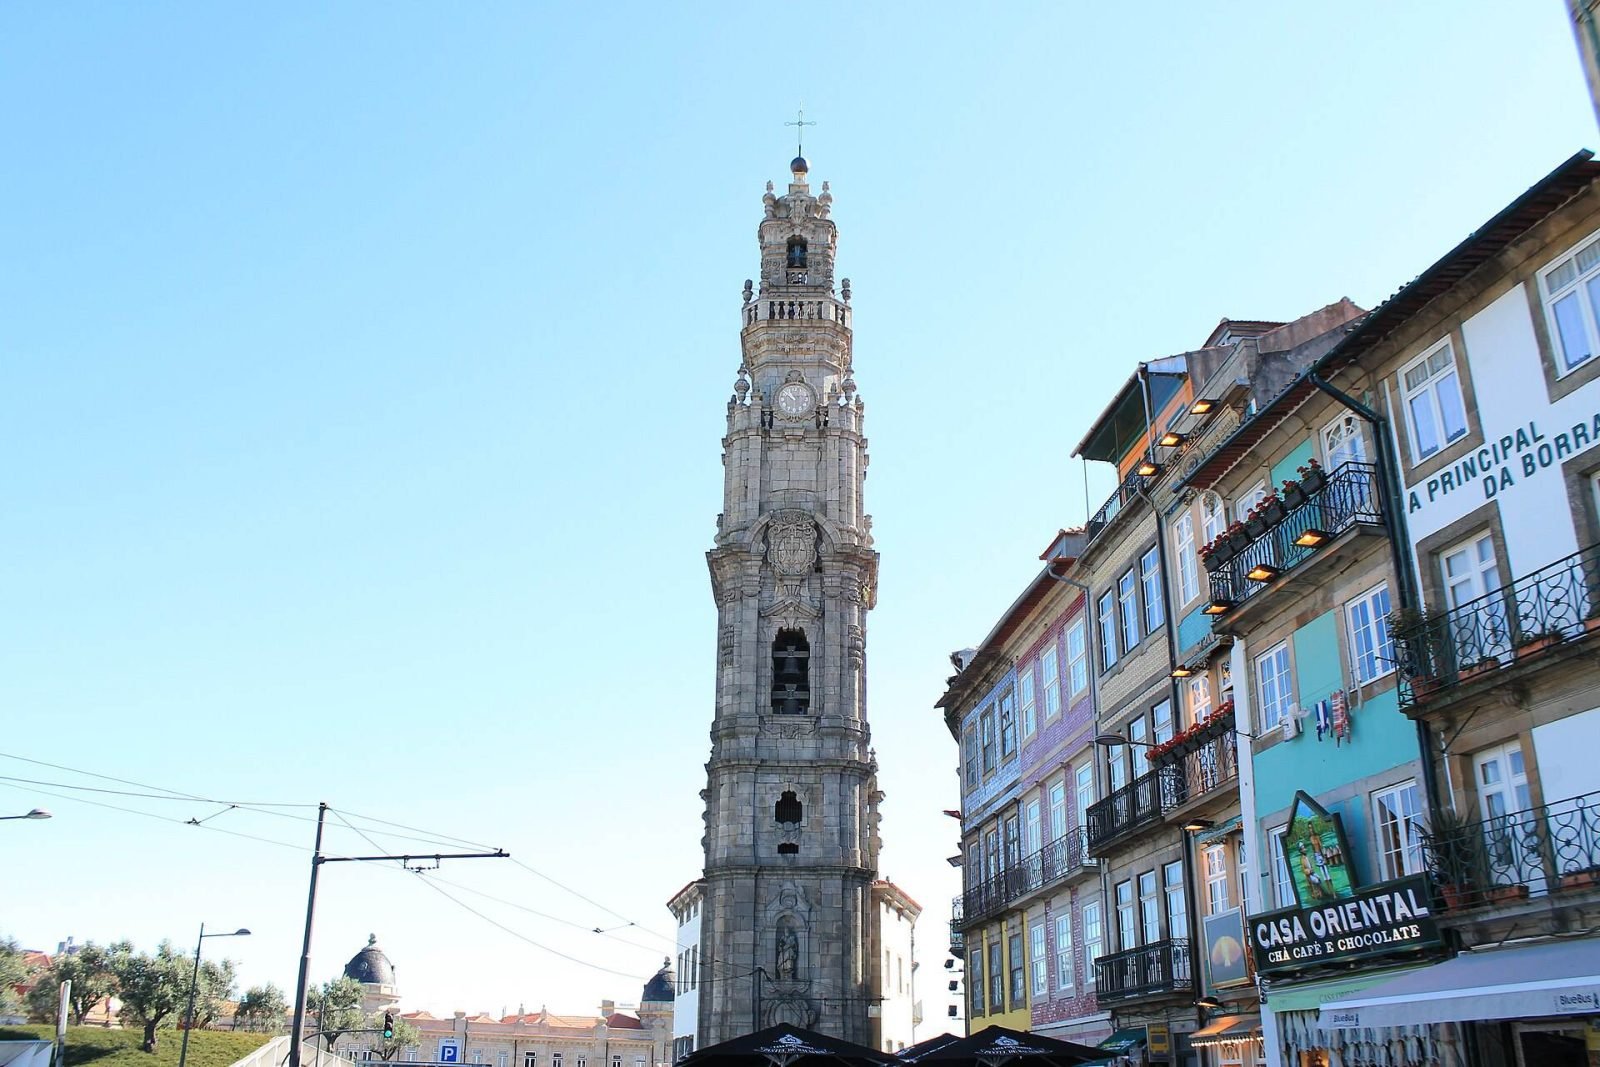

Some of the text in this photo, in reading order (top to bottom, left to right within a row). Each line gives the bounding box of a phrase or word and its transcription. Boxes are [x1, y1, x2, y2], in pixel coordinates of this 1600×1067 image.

[1409, 421, 1545, 514] A PRINCIPAL
[1483, 466, 1514, 499] DA
[1256, 888, 1430, 949] CASA ORIENTAL
[1325, 941, 1335, 953] E
[1337, 924, 1421, 951] CHOCOLATE
[444, 1048, 454, 1060] P
